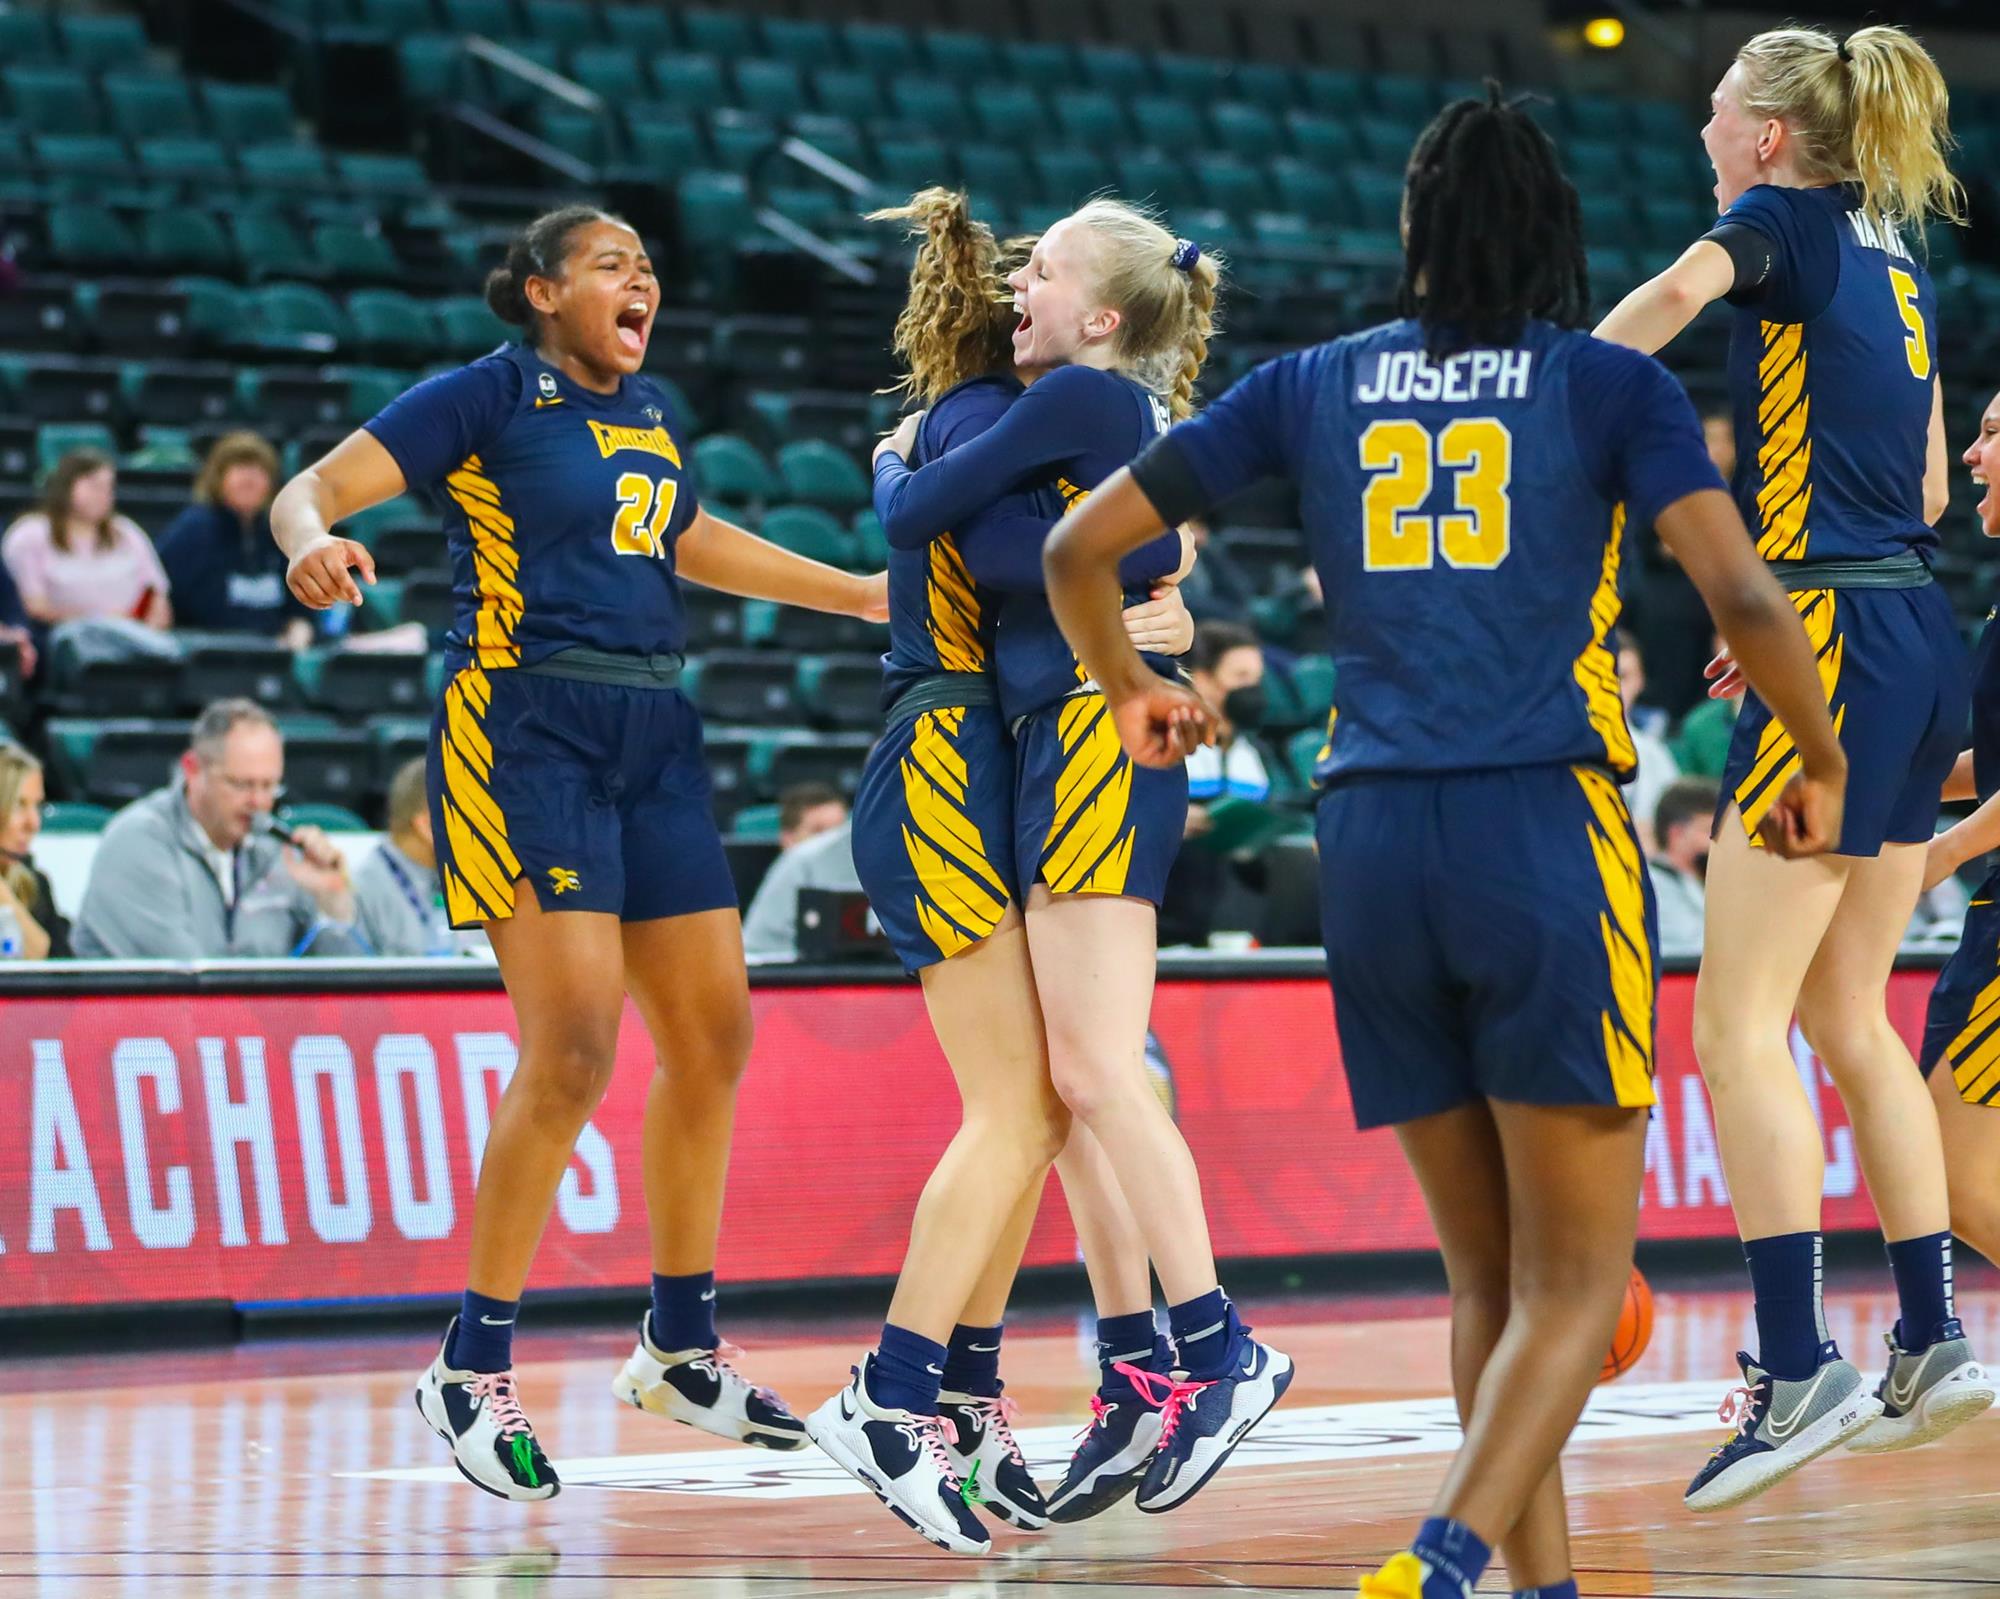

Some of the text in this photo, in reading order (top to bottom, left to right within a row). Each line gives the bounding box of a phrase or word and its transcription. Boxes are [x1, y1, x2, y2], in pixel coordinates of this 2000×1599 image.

[1888, 266, 1931, 381] 5
[1357, 349, 1532, 403] JOSEPH
[611, 472, 678, 560] 21
[1358, 416, 1513, 573] 23
